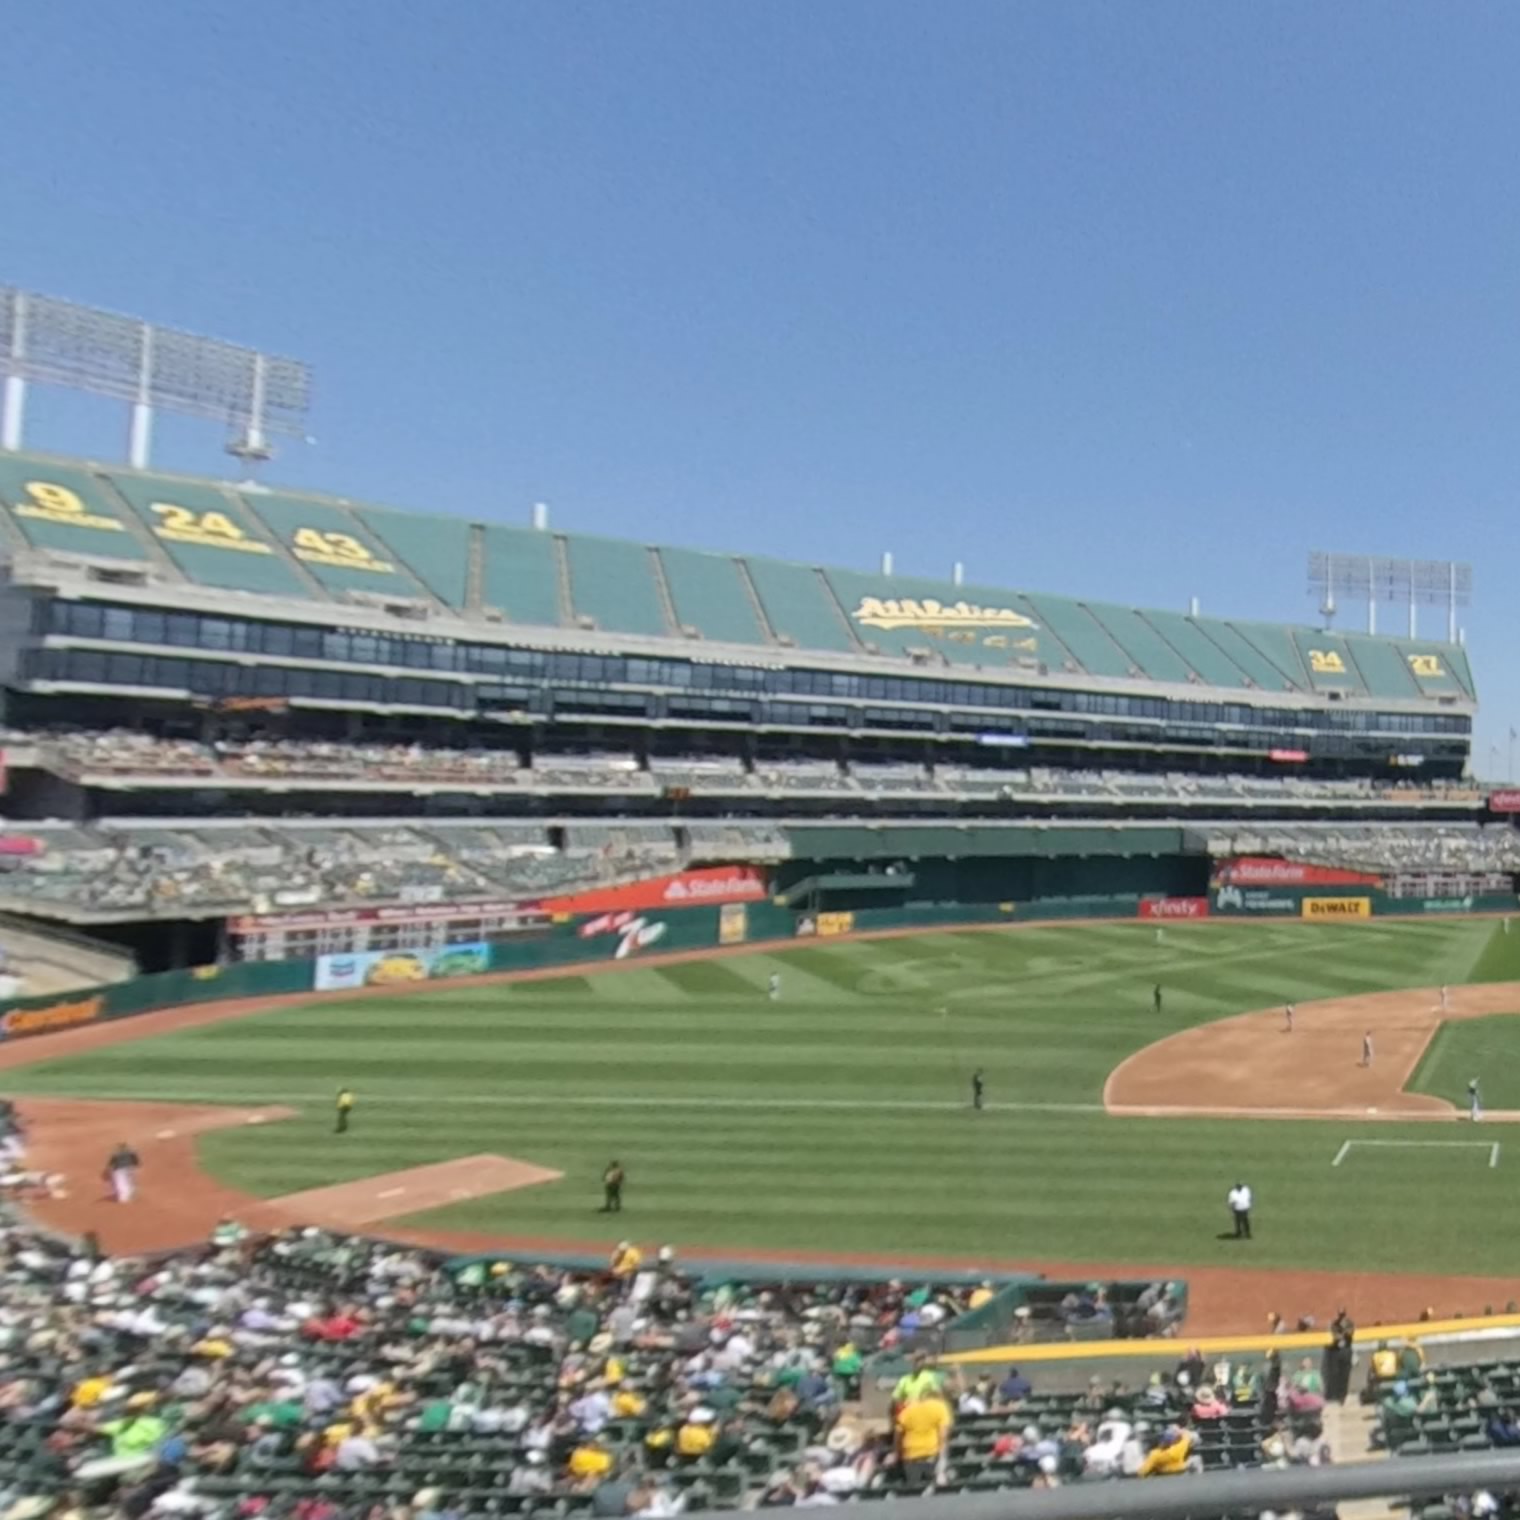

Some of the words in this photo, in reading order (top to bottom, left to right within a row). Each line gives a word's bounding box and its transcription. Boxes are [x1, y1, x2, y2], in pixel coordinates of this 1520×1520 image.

[25, 481, 84, 514] 9
[151, 503, 244, 538] 24
[294, 528, 372, 560] 43
[852, 597, 1040, 631] Athletics
[1309, 650, 1342, 668] 34
[1408, 655, 1438, 674] 27
[1150, 898, 1198, 917] xfinity
